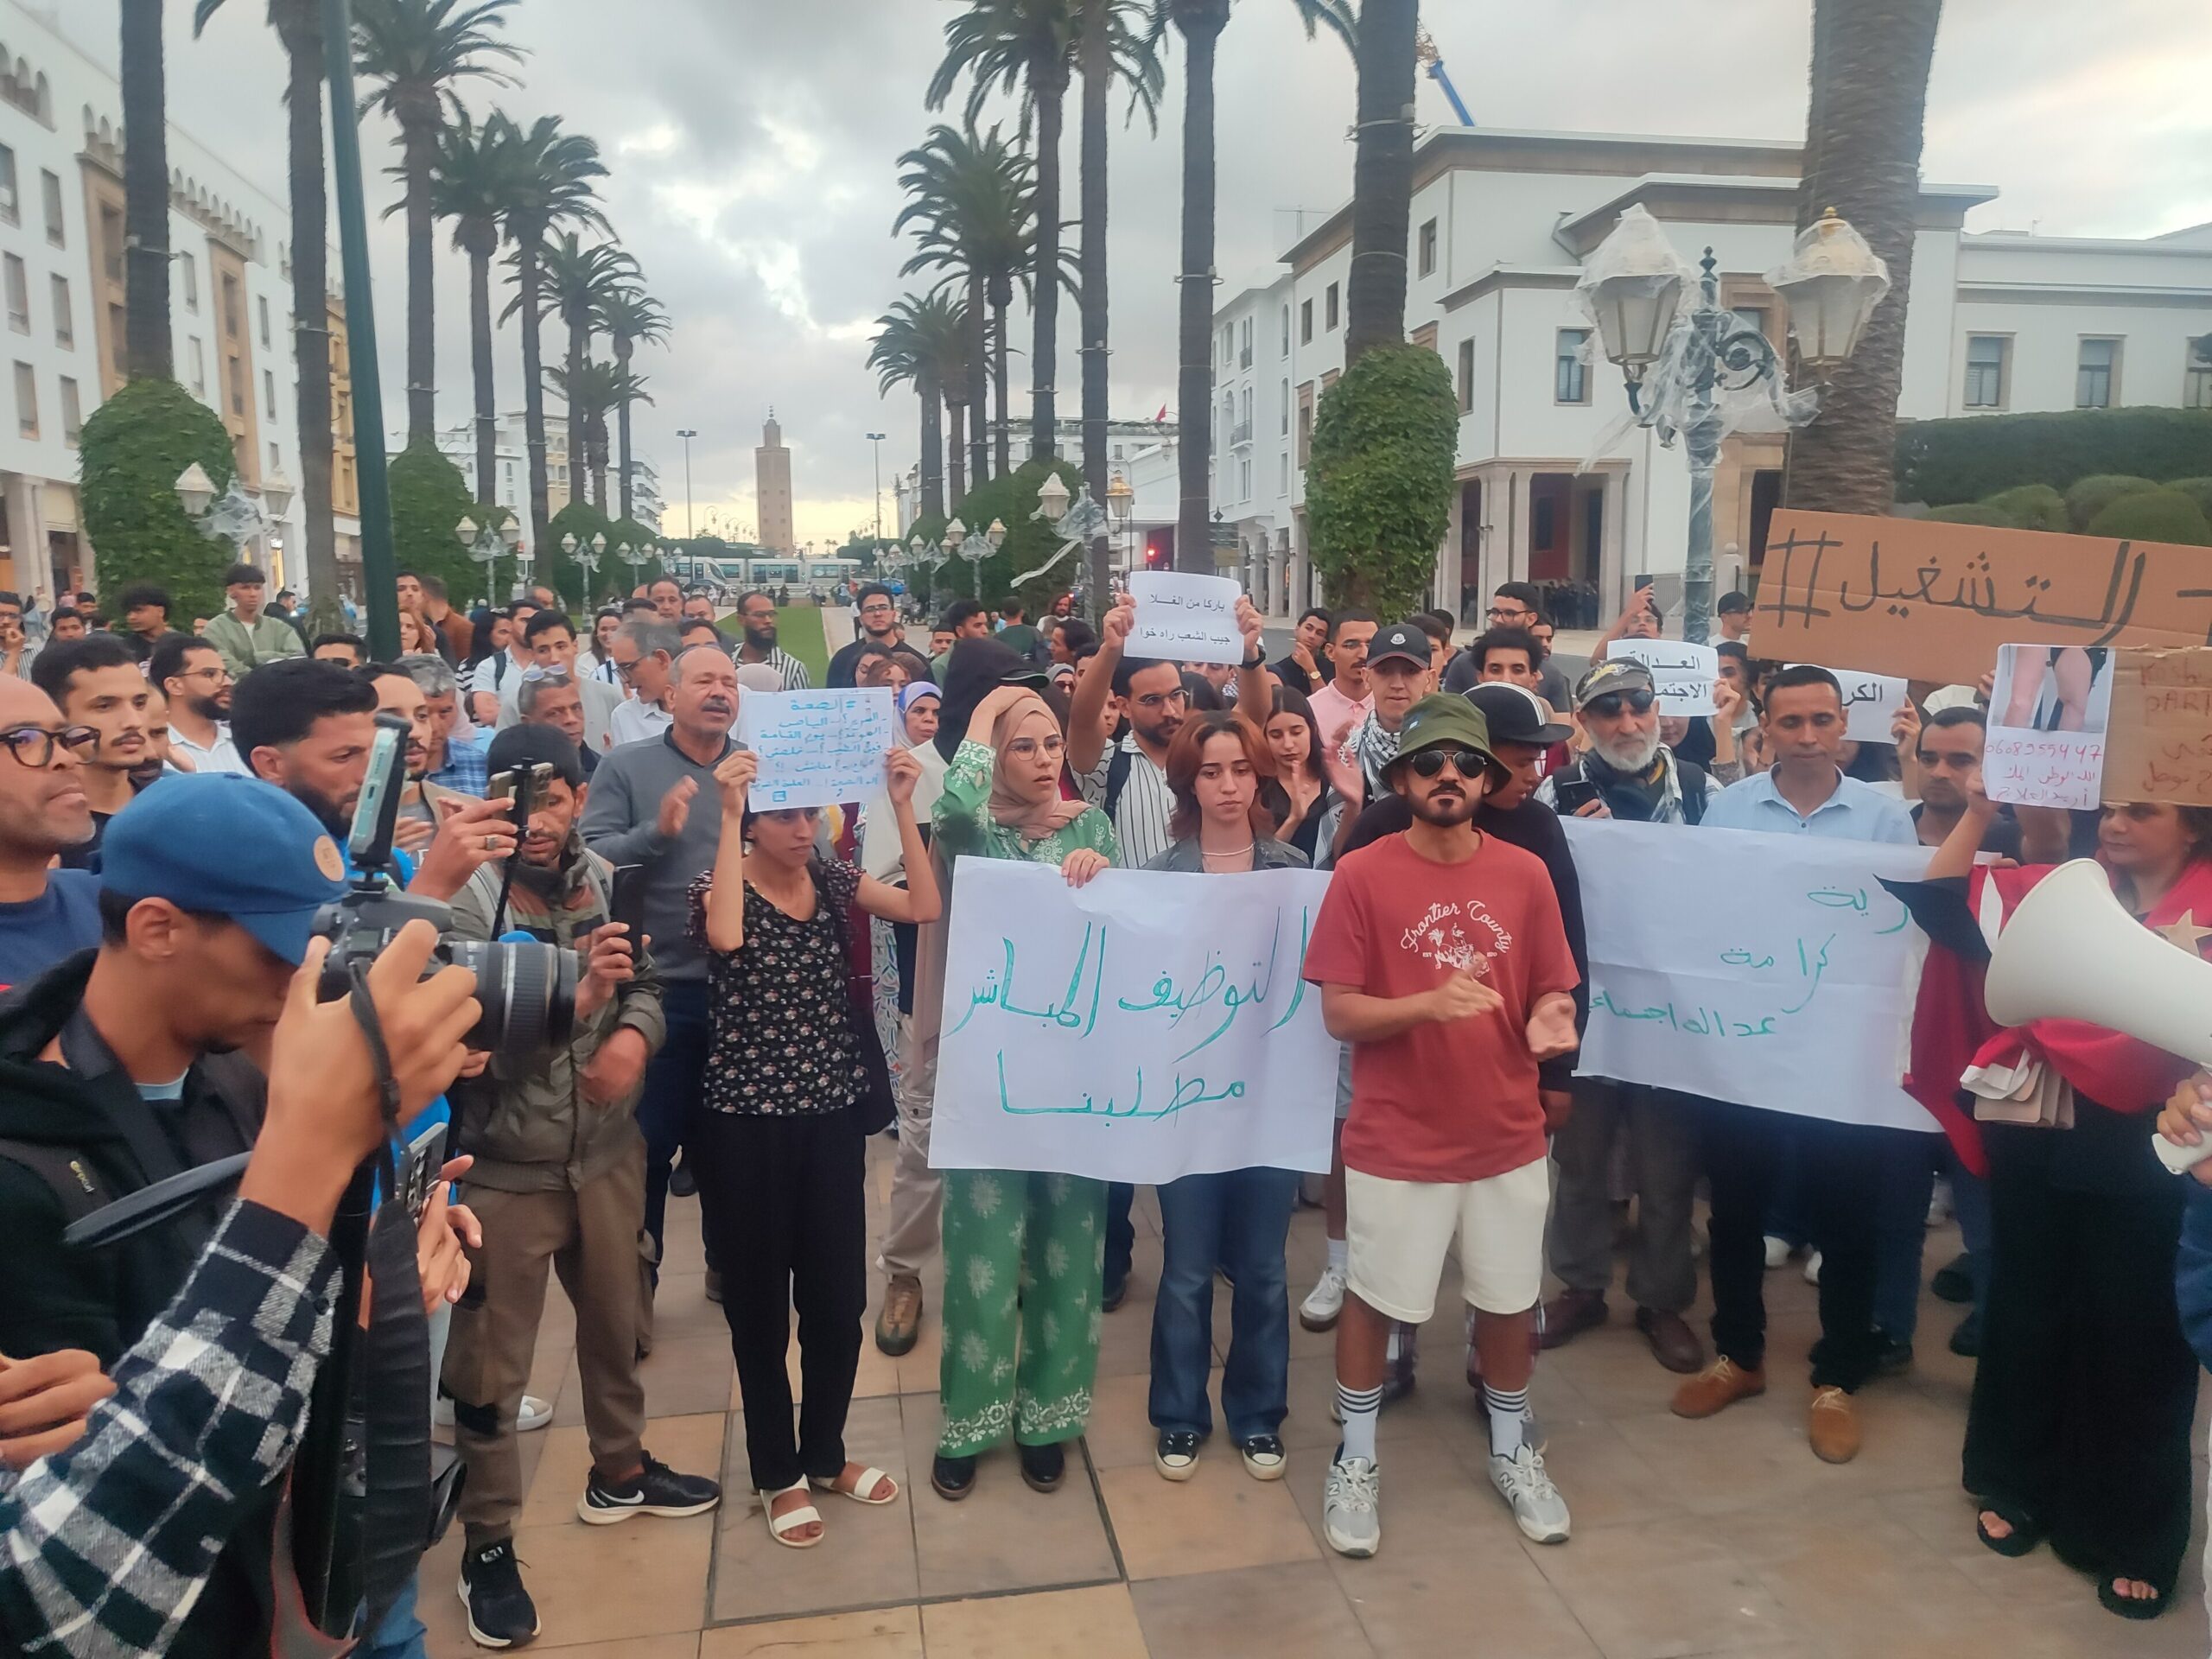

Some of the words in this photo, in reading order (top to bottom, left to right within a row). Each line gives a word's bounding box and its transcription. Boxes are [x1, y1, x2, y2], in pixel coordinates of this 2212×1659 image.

[1185, 599, 1200, 610] من
[1203, 598, 1225, 612] باركا
[1140, 626, 1157, 639] خوا
[1159, 628, 1175, 641] راه
[1177, 631, 1207, 642] الشعب
[1209, 634, 1231, 645] جيب
[1654, 682, 1707, 702] الاجتم
[1841, 682, 1885, 708] الكر
[1807, 886, 1909, 935] رية
[1400, 902, 1461, 953] Frontier
[1466, 899, 1513, 953] County
[939, 920, 1107, 1039] المباشر
[1117, 904, 1309, 1064] التوظيف
[995, 1048, 1245, 1129] مطلبنا
